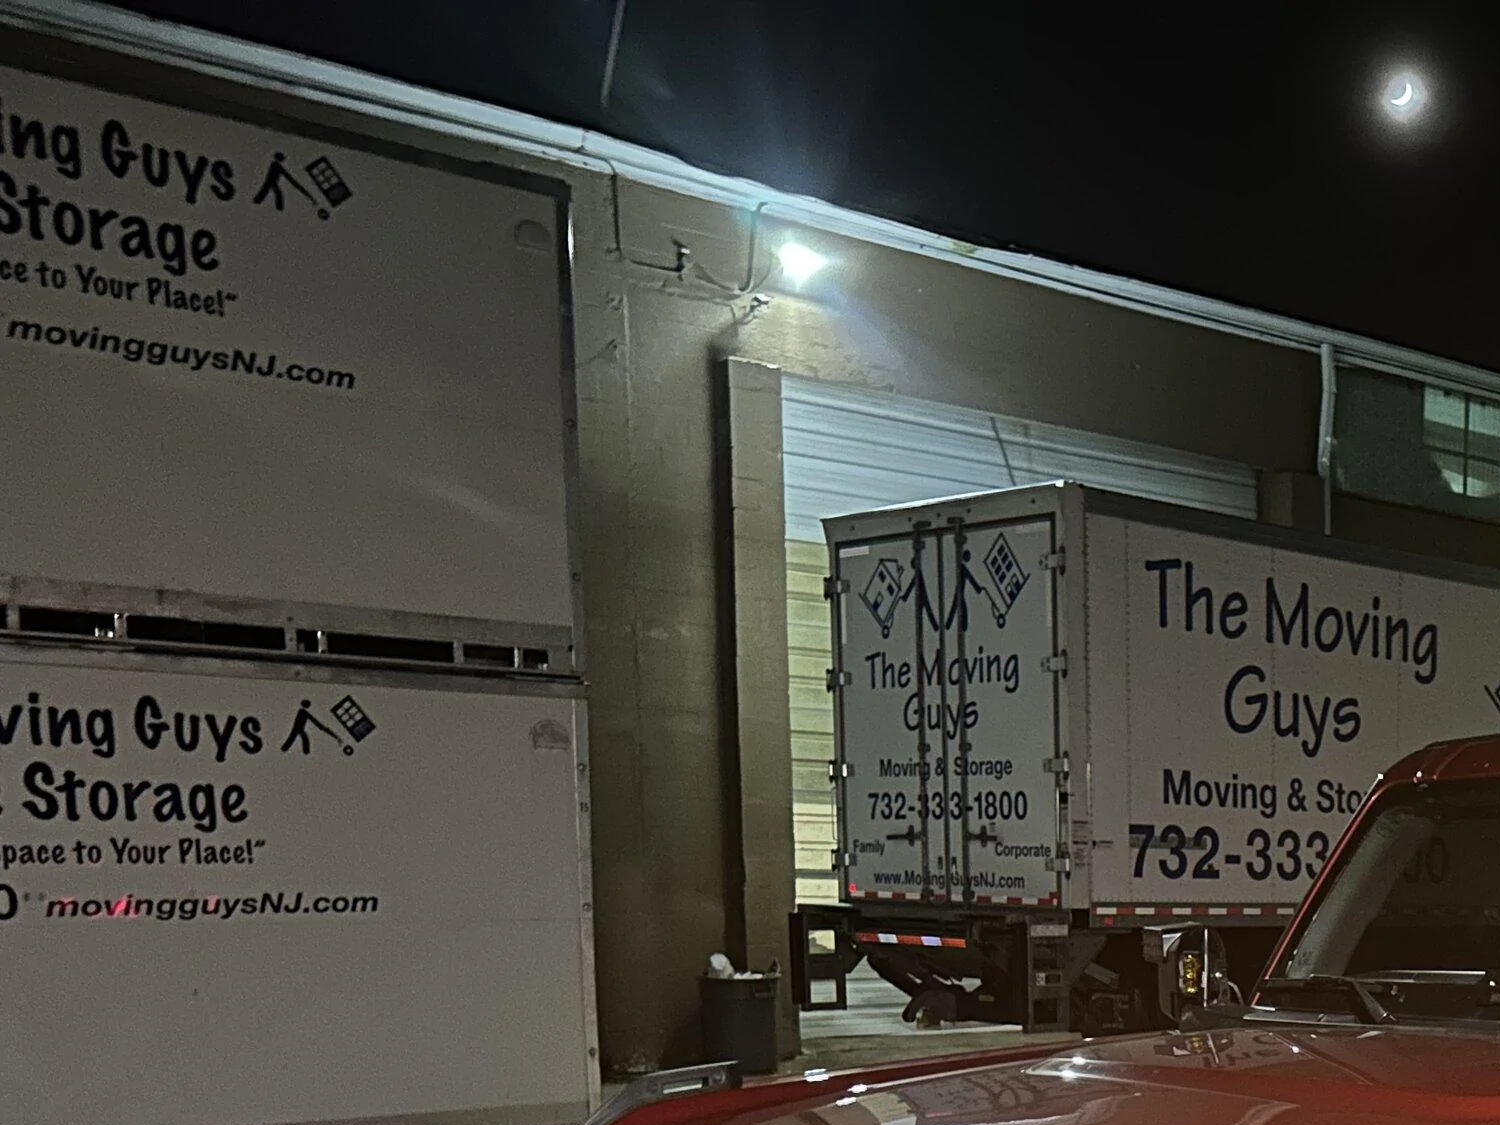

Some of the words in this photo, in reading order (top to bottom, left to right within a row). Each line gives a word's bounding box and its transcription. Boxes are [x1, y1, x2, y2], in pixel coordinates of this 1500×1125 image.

[102, 119, 236, 204] Guys
[35, 261, 66, 289] to
[75, 264, 139, 301] Your
[6, 320, 356, 390] movingguysNJ.com
[1145, 558, 1248, 639] The
[1265, 577, 1438, 684] Moving
[865, 652, 911, 689] The
[917, 646, 1019, 693] Moving
[134, 695, 263, 763] Guys
[904, 693, 979, 740] Guys
[1223, 664, 1361, 757] Guys
[880, 758, 930, 781] Moving
[935, 757, 945, 776] &
[22, 761, 248, 833] Storage
[868, 791, 1028, 820] 732-333-1800
[1162, 769, 1277, 819] Moving
[1288, 778, 1308, 812] &
[1316, 779, 1368, 814] Sto
[2, 844, 66, 870] pace
[72, 841, 102, 864] to
[109, 837, 171, 865] Your
[853, 840, 885, 856] Family
[995, 841, 1051, 859] Corporate
[874, 870, 1025, 889] www.MoingGuysNJ.com
[45, 893, 378, 920] movingguysNJ.com
